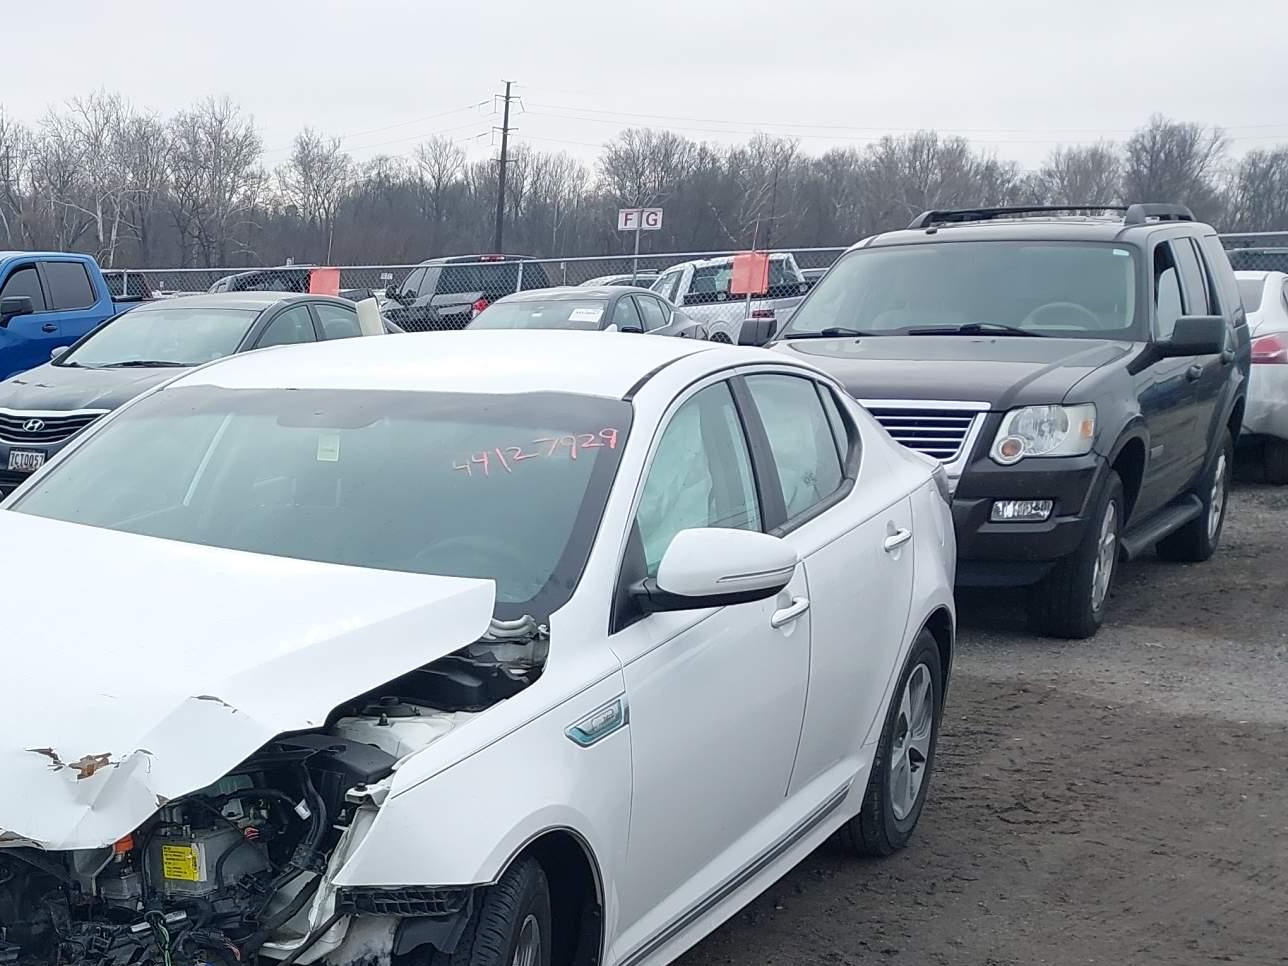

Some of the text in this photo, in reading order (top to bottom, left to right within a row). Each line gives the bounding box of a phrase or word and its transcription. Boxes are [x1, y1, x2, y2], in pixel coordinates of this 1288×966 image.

[623, 211, 658, 227] F G
[452, 428, 618, 478] 44127929
